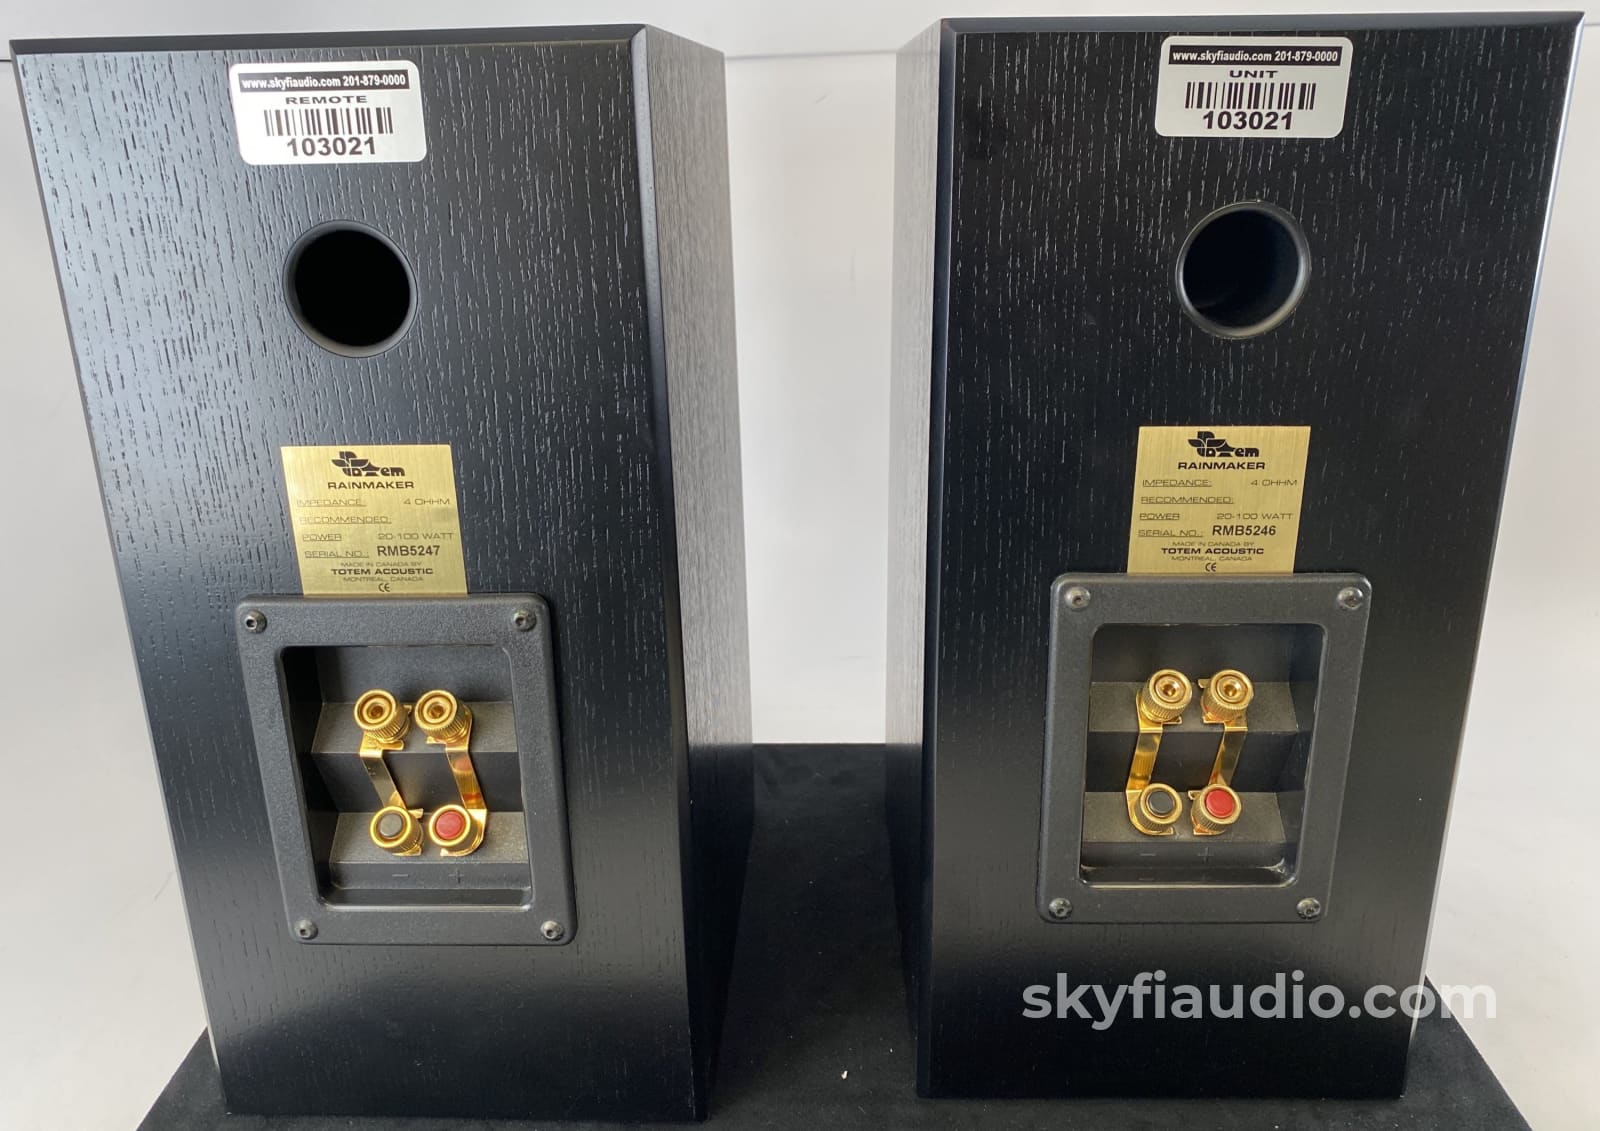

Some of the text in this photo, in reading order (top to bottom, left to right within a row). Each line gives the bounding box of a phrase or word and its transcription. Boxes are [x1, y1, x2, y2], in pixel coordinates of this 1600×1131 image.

[1173, 50, 1338, 63] www.skyfiaudio.com 201-879-0000
[1229, 70, 1278, 78] UNIT
[242, 75, 406, 90] www.skyfiaudio.com 201-879-0000
[285, 96, 368, 104] REMOTE
[1203, 111, 1292, 130] 103021
[287, 137, 376, 156] 103021
[1178, 462, 1265, 470] RAINMAKER
[1212, 525, 1276, 536] RMB5246
[377, 546, 440, 556] RMB5247
